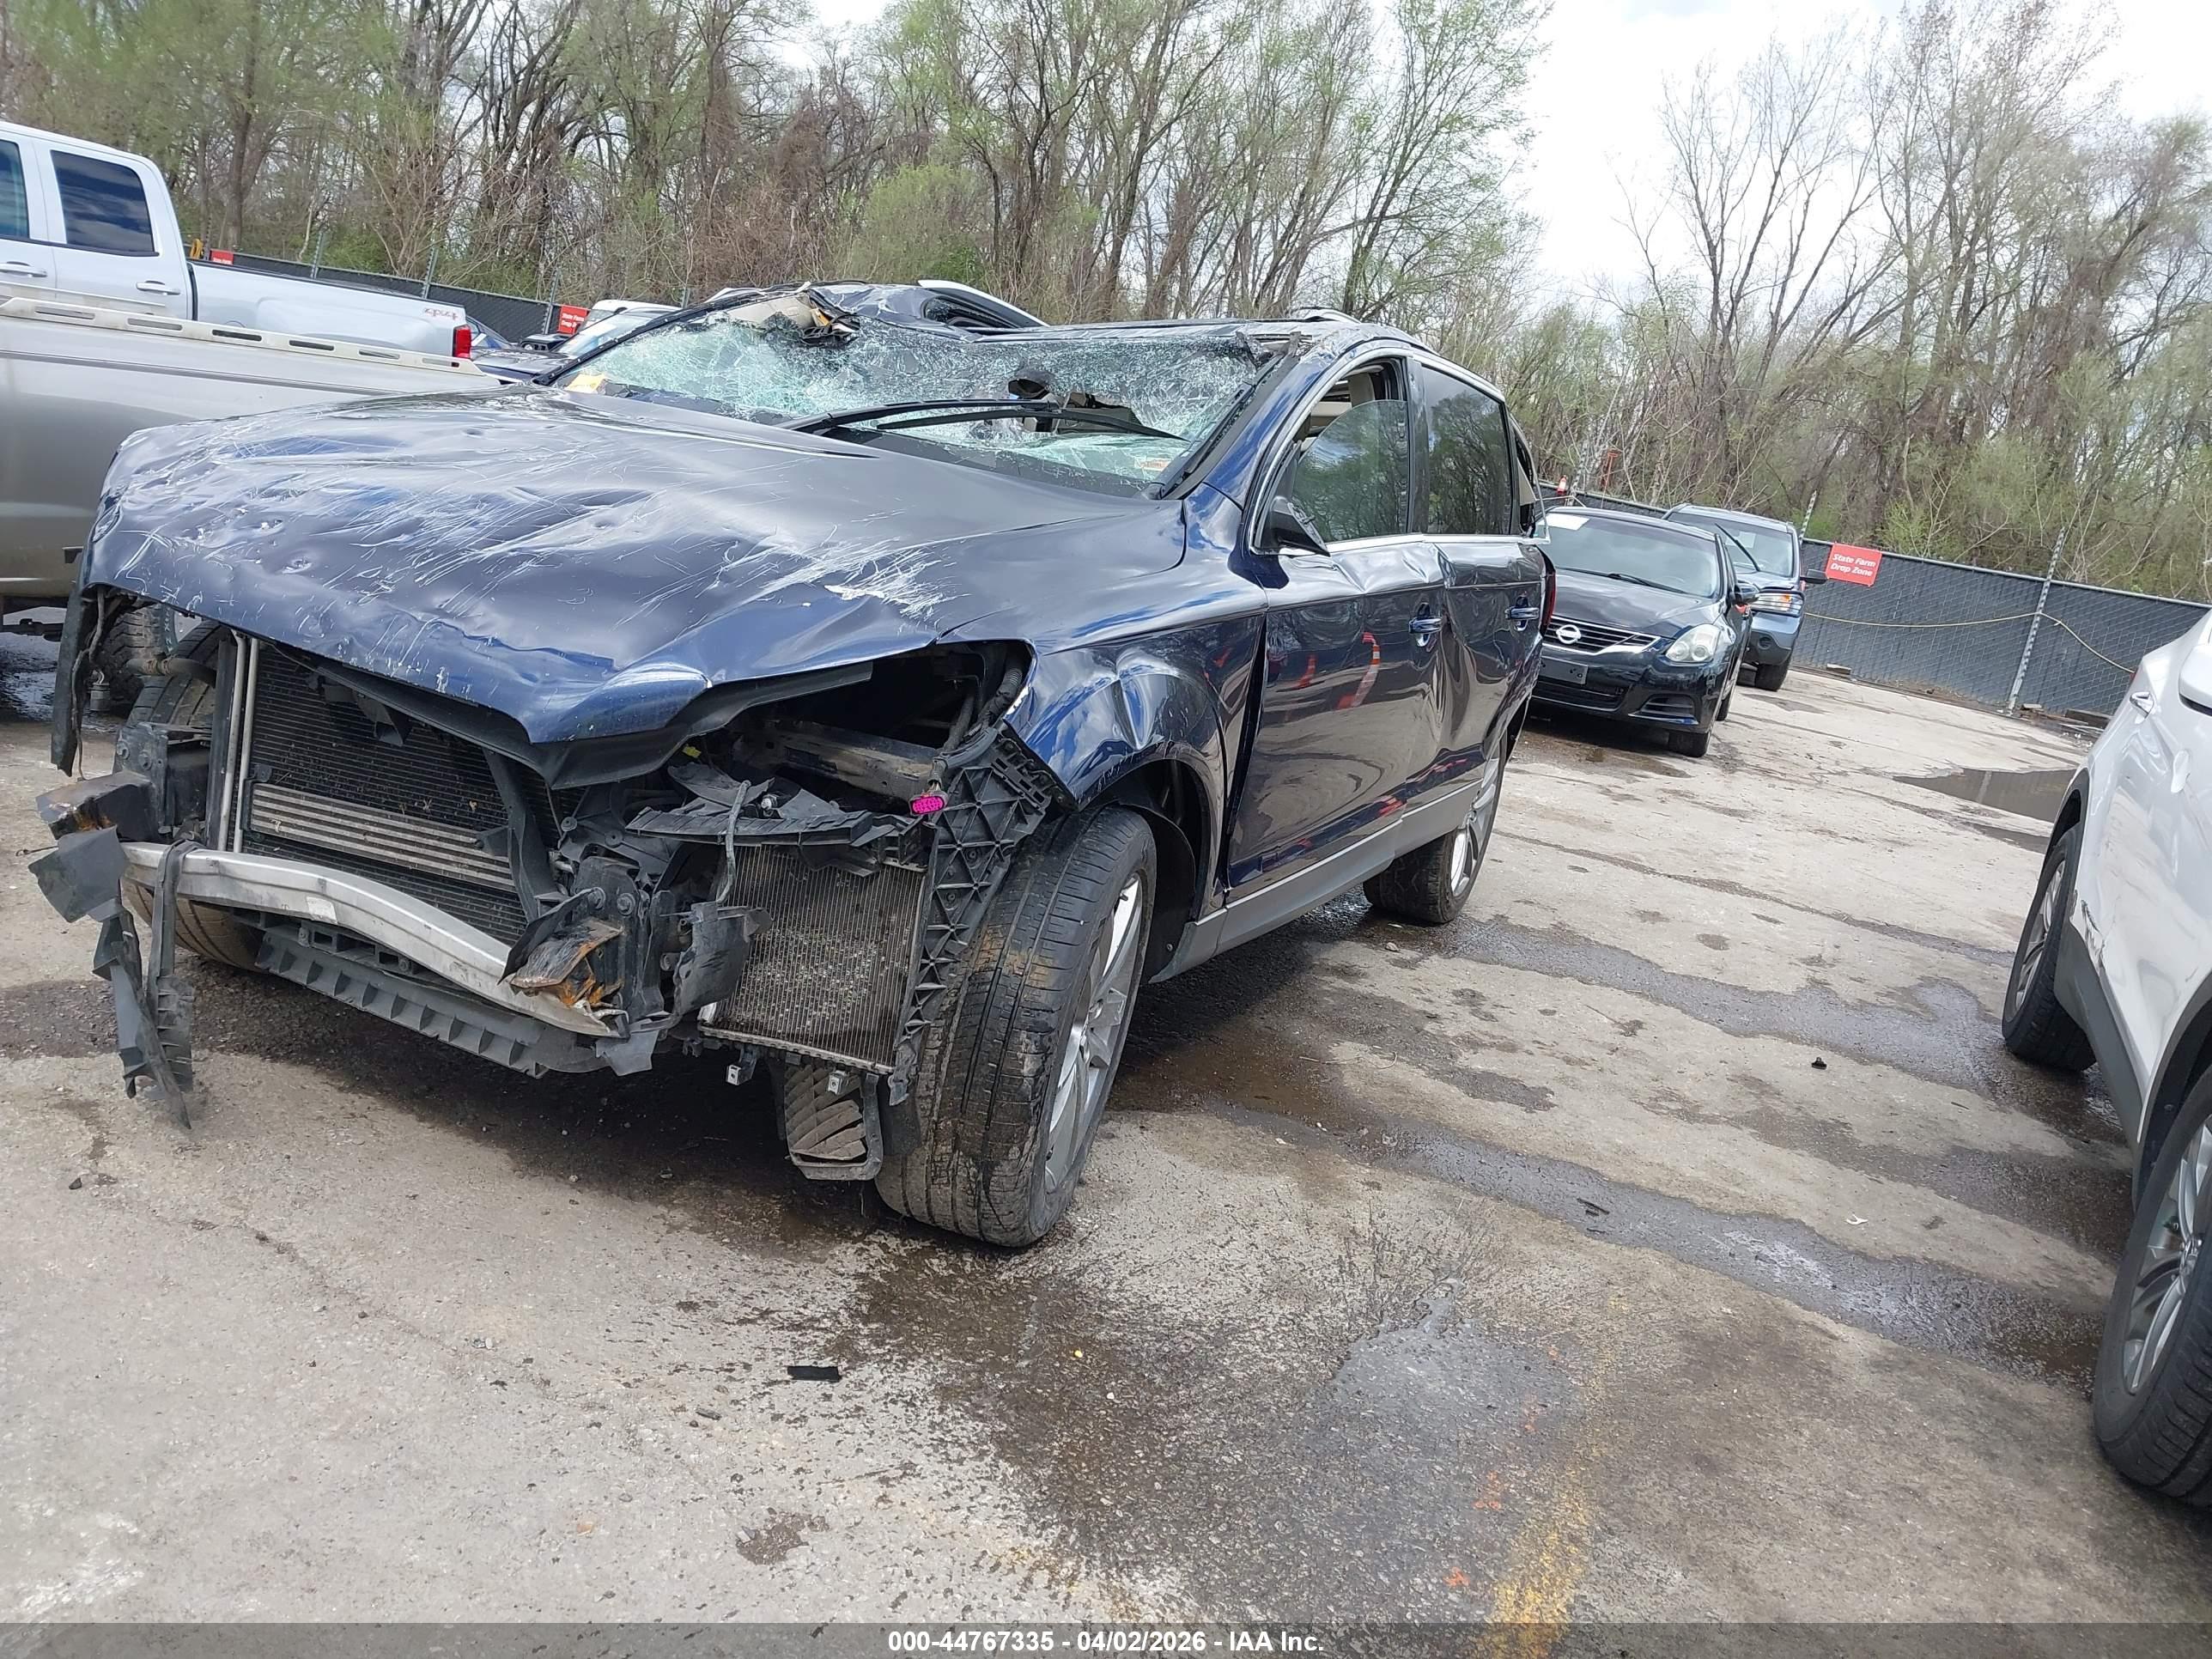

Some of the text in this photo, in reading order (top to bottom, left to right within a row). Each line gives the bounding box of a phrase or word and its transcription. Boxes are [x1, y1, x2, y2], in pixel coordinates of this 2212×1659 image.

[1832, 554, 1876, 568] State Farm
[1830, 562, 1873, 576] Drop Zone
